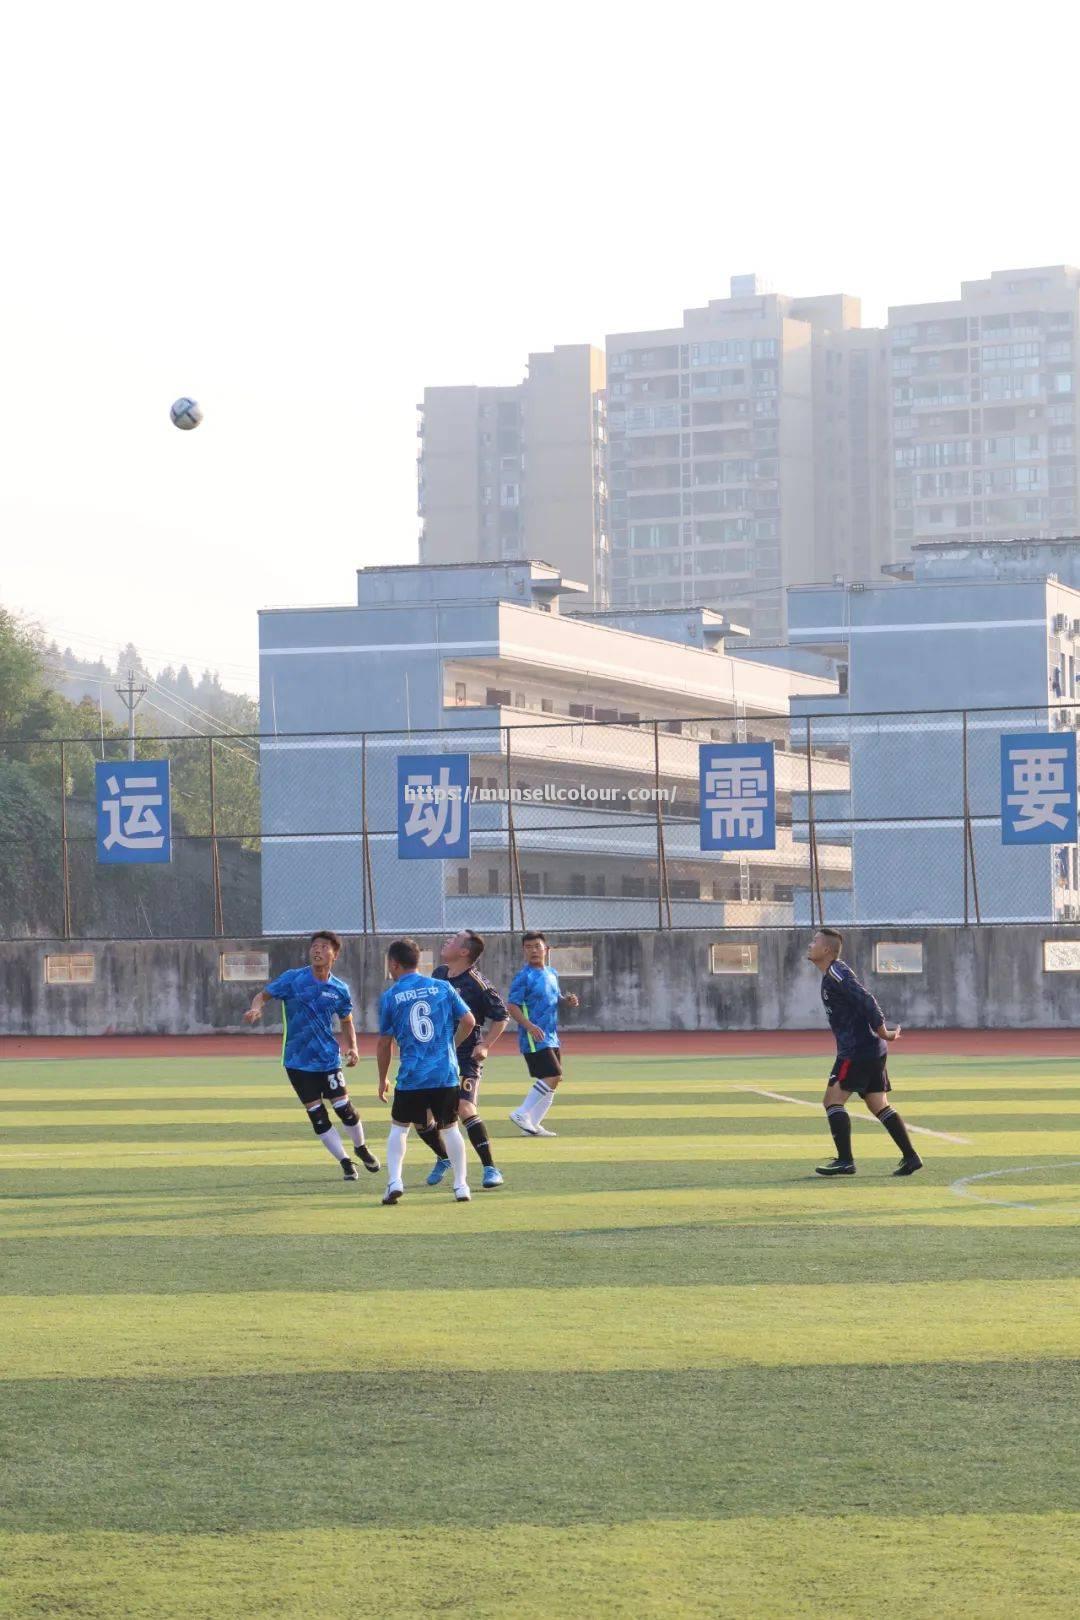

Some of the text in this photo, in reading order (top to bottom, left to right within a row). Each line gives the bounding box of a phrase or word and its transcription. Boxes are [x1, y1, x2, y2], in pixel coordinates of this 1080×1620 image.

[102, 748, 1071, 851] 运 动 需 要
[409, 1000, 434, 1043] 6
